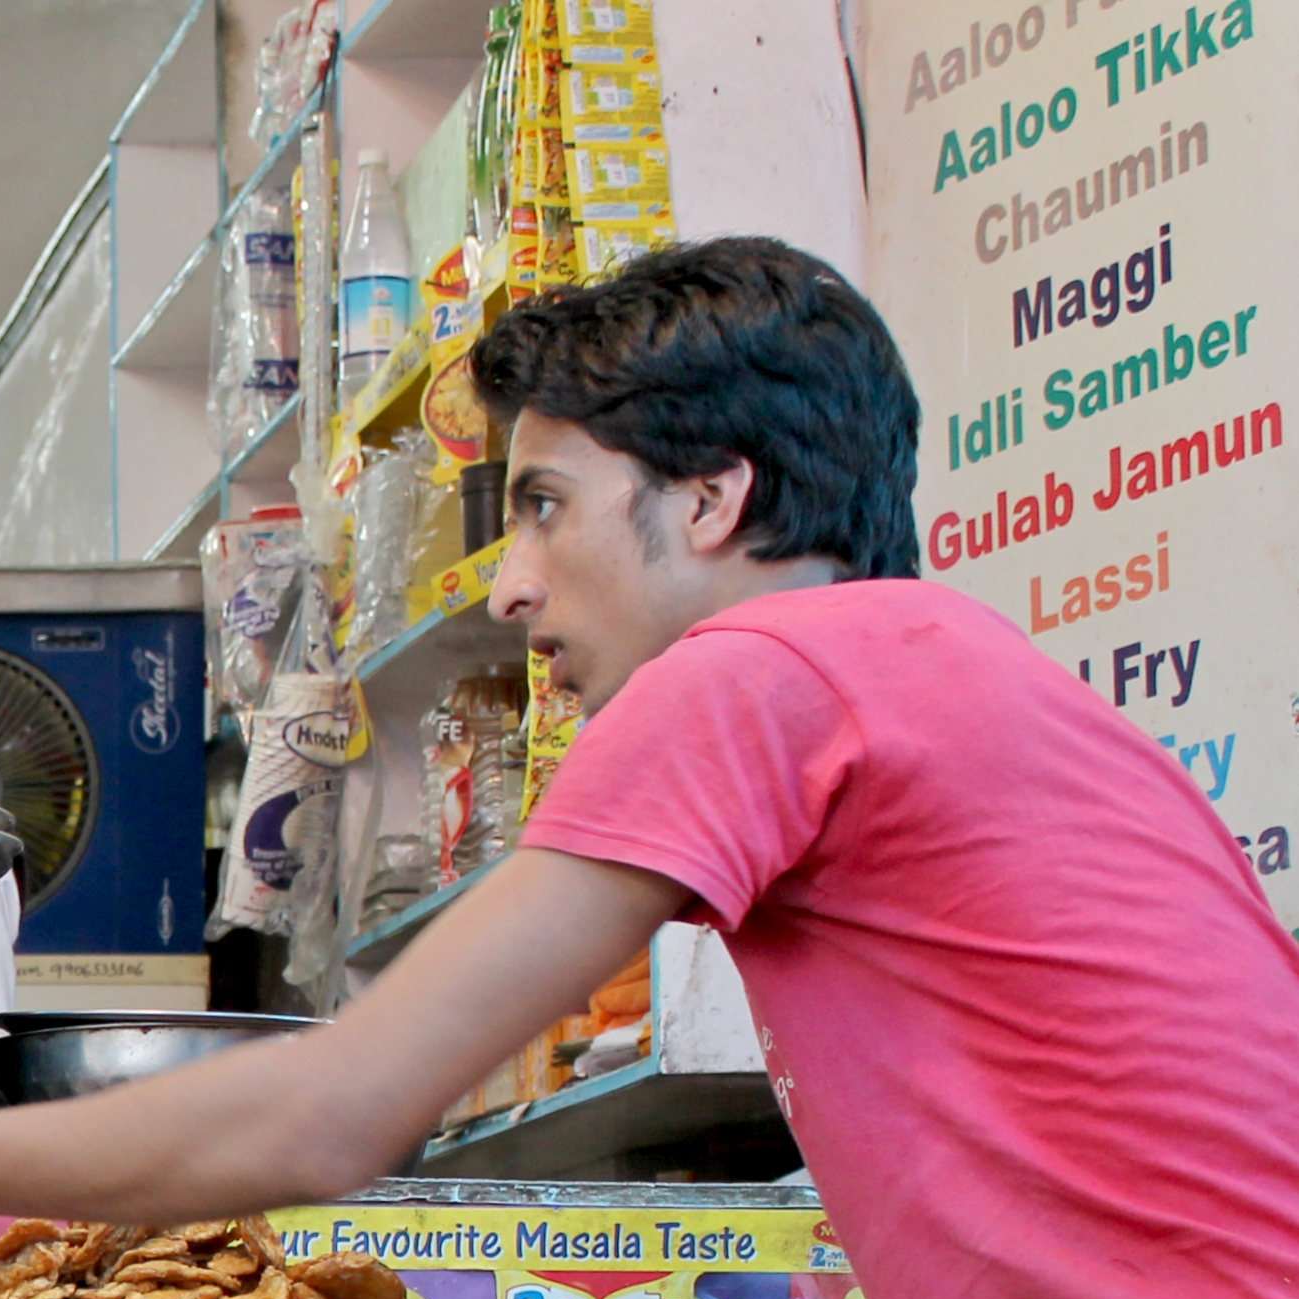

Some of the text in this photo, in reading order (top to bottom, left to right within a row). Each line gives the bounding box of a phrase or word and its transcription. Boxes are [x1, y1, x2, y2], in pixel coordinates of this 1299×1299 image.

[904, 5, 1046, 116] Aaloo
[933, 0, 1255, 194] Aaloo Tikka
[974, 119, 1210, 265] Chaumin
[1012, 222, 1173, 349] Maggi
[948, 304, 1259, 472] Idli Samber
[927, 401, 1283, 572] Gulab Jamun
[1029, 530, 1171, 636] Lassi
[1112, 638, 1202, 708] Fry
[331, 1219, 503, 1262] Favourite
[514, 1219, 642, 1262] Masala
[654, 1221, 757, 1264] Taste
